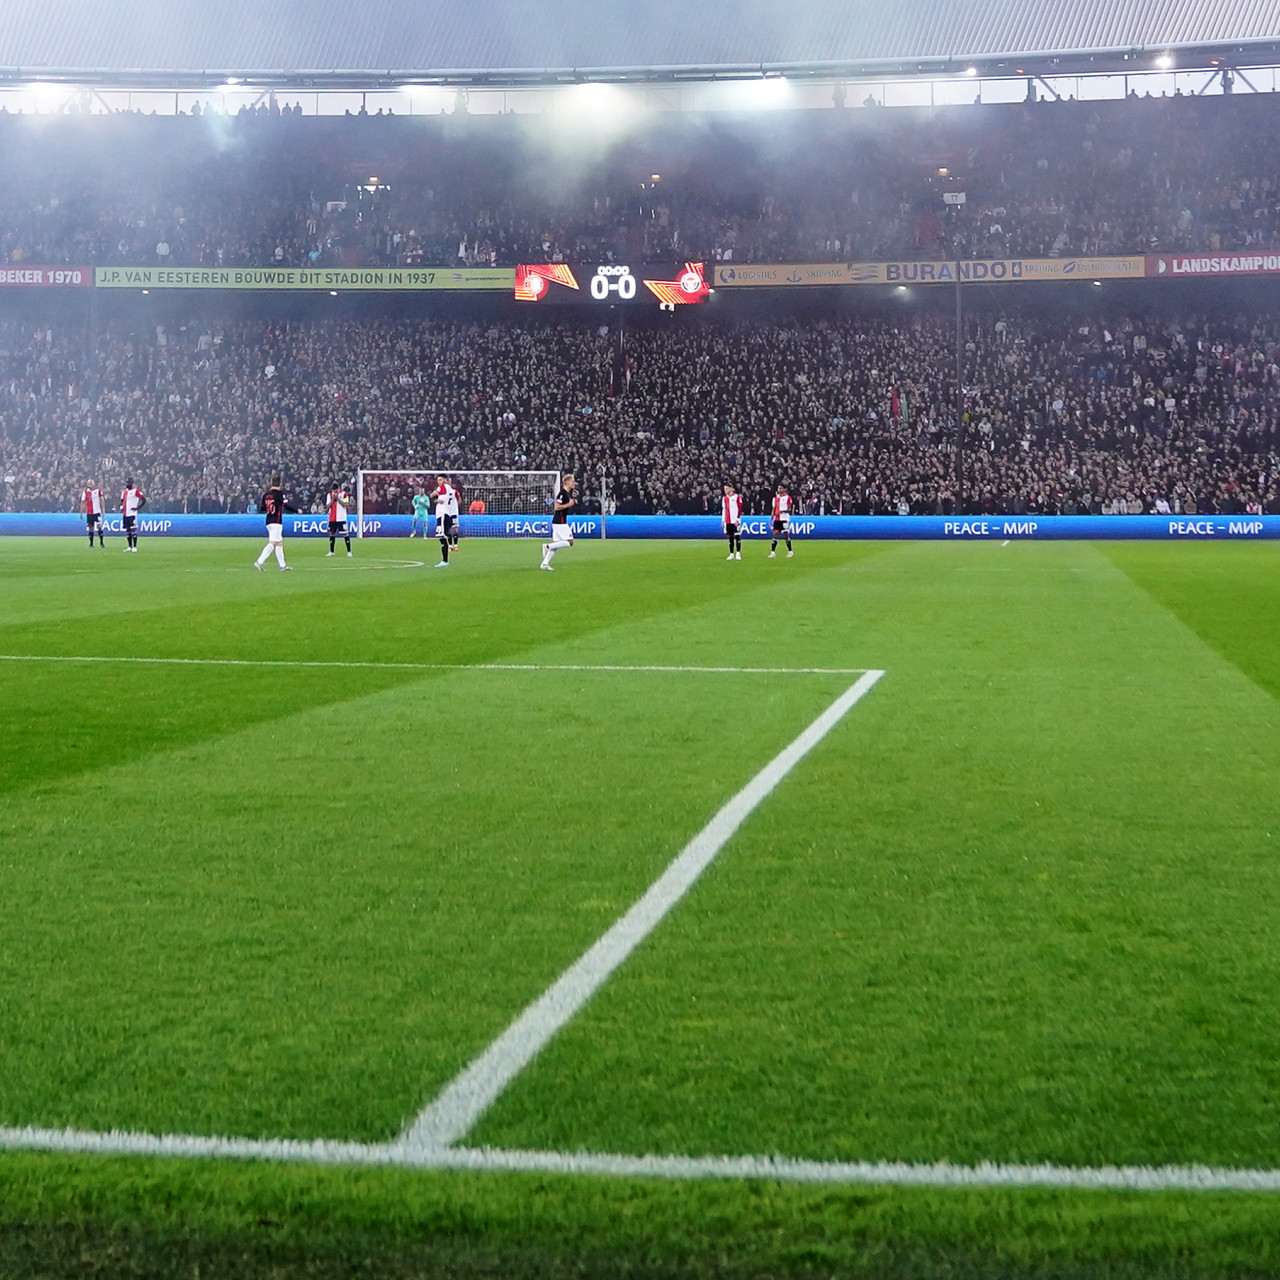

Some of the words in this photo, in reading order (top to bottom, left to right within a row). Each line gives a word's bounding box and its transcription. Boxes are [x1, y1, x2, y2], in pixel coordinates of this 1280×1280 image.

[47, 270, 82, 284] 1970
[886, 261, 1007, 281] BURANDO
[100, 272, 121, 283] J.P.
[125, 272, 152, 283] VAN
[157, 272, 229, 283] EESTEREN
[235, 272, 295, 284] BOUWDE
[300, 273, 322, 284] DIT
[325, 272, 386, 284] STADION
[389, 273, 403, 284] IN
[407, 272, 435, 284] 1937
[590, 275, 637, 300] 0-0
[944, 522, 990, 535] PEACE
[1003, 522, 1038, 535] МИР
[1169, 522, 1215, 534] PEACE
[1228, 522, 1263, 534] МИР
